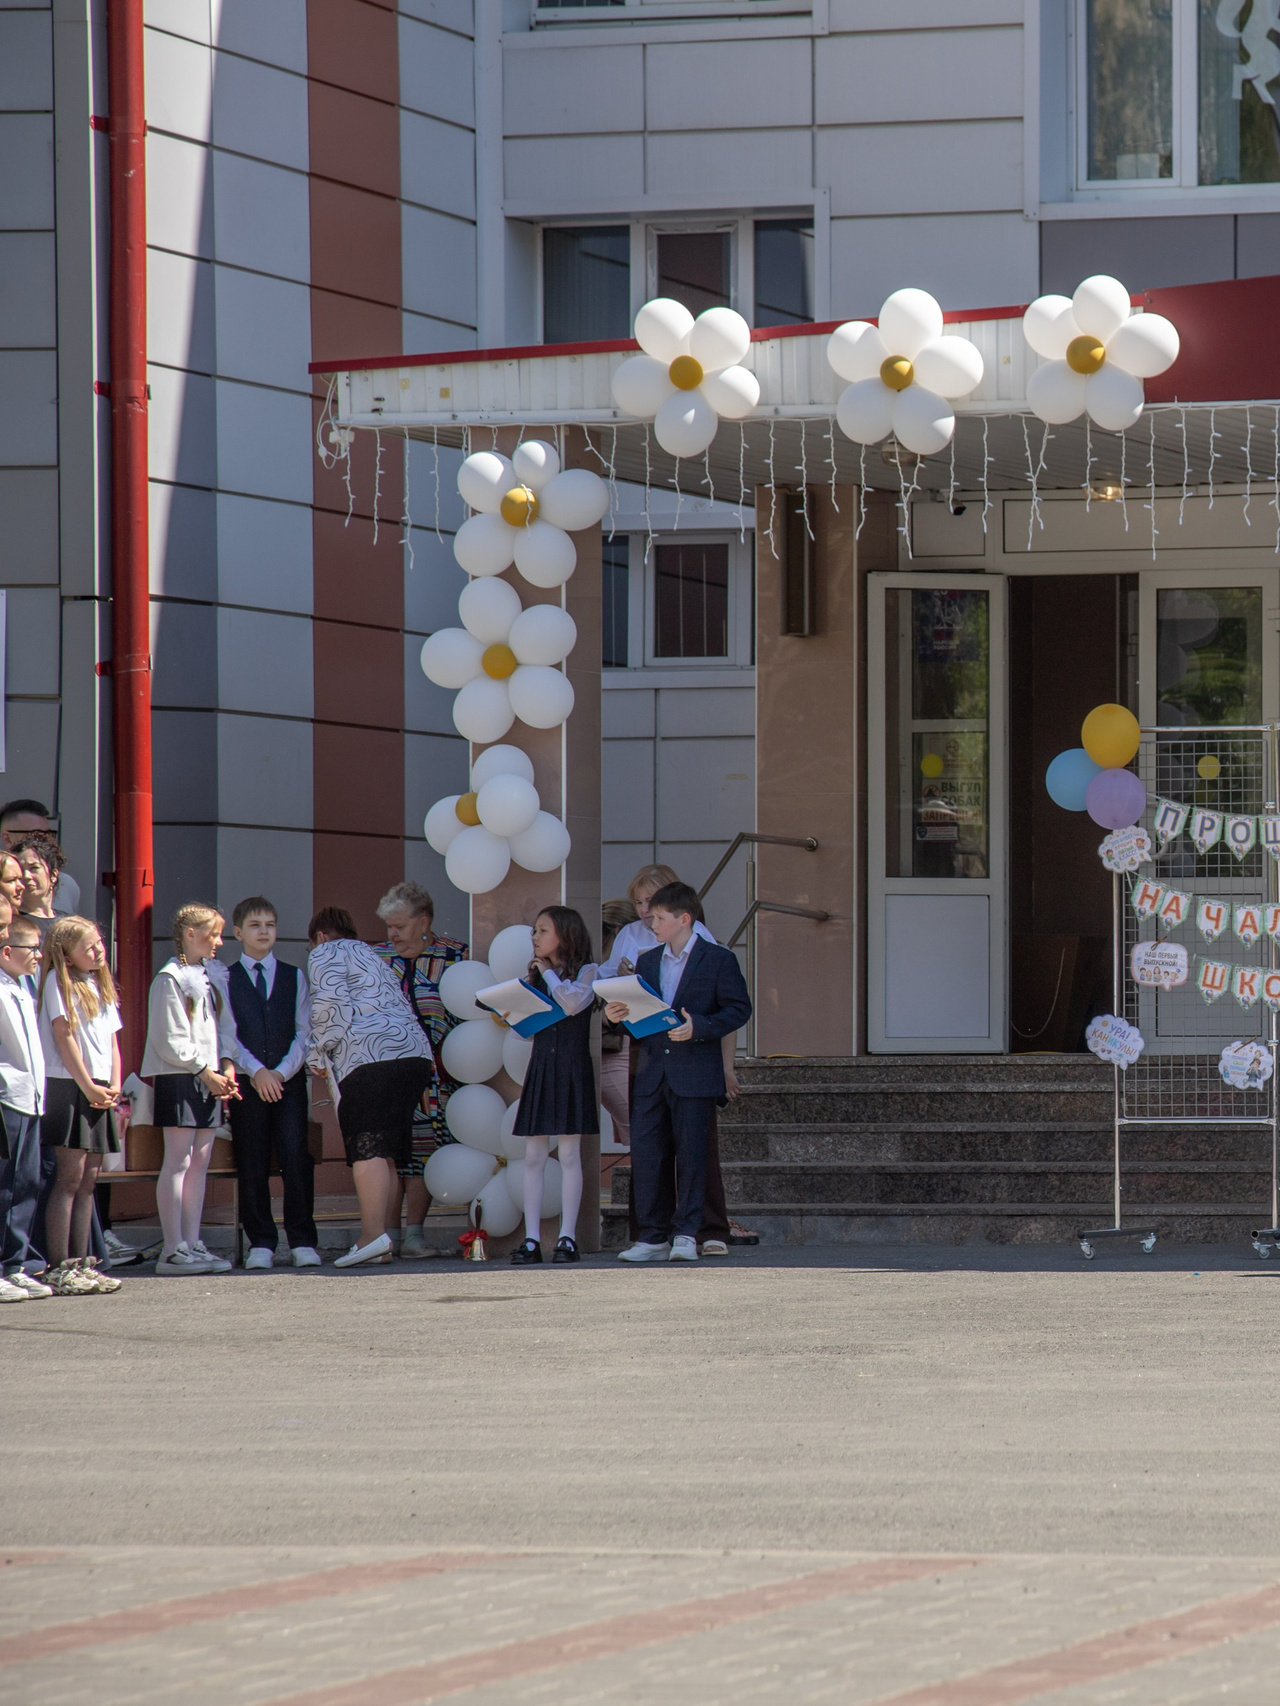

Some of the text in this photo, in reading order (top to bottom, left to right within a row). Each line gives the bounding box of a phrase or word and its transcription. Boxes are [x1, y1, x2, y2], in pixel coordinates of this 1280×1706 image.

[941, 782, 981, 793] ВЫГУЛ
[1109, 1023, 1131, 1042] УРА!
[1091, 1028, 1138, 1057] КАНИКУЛЫ!
